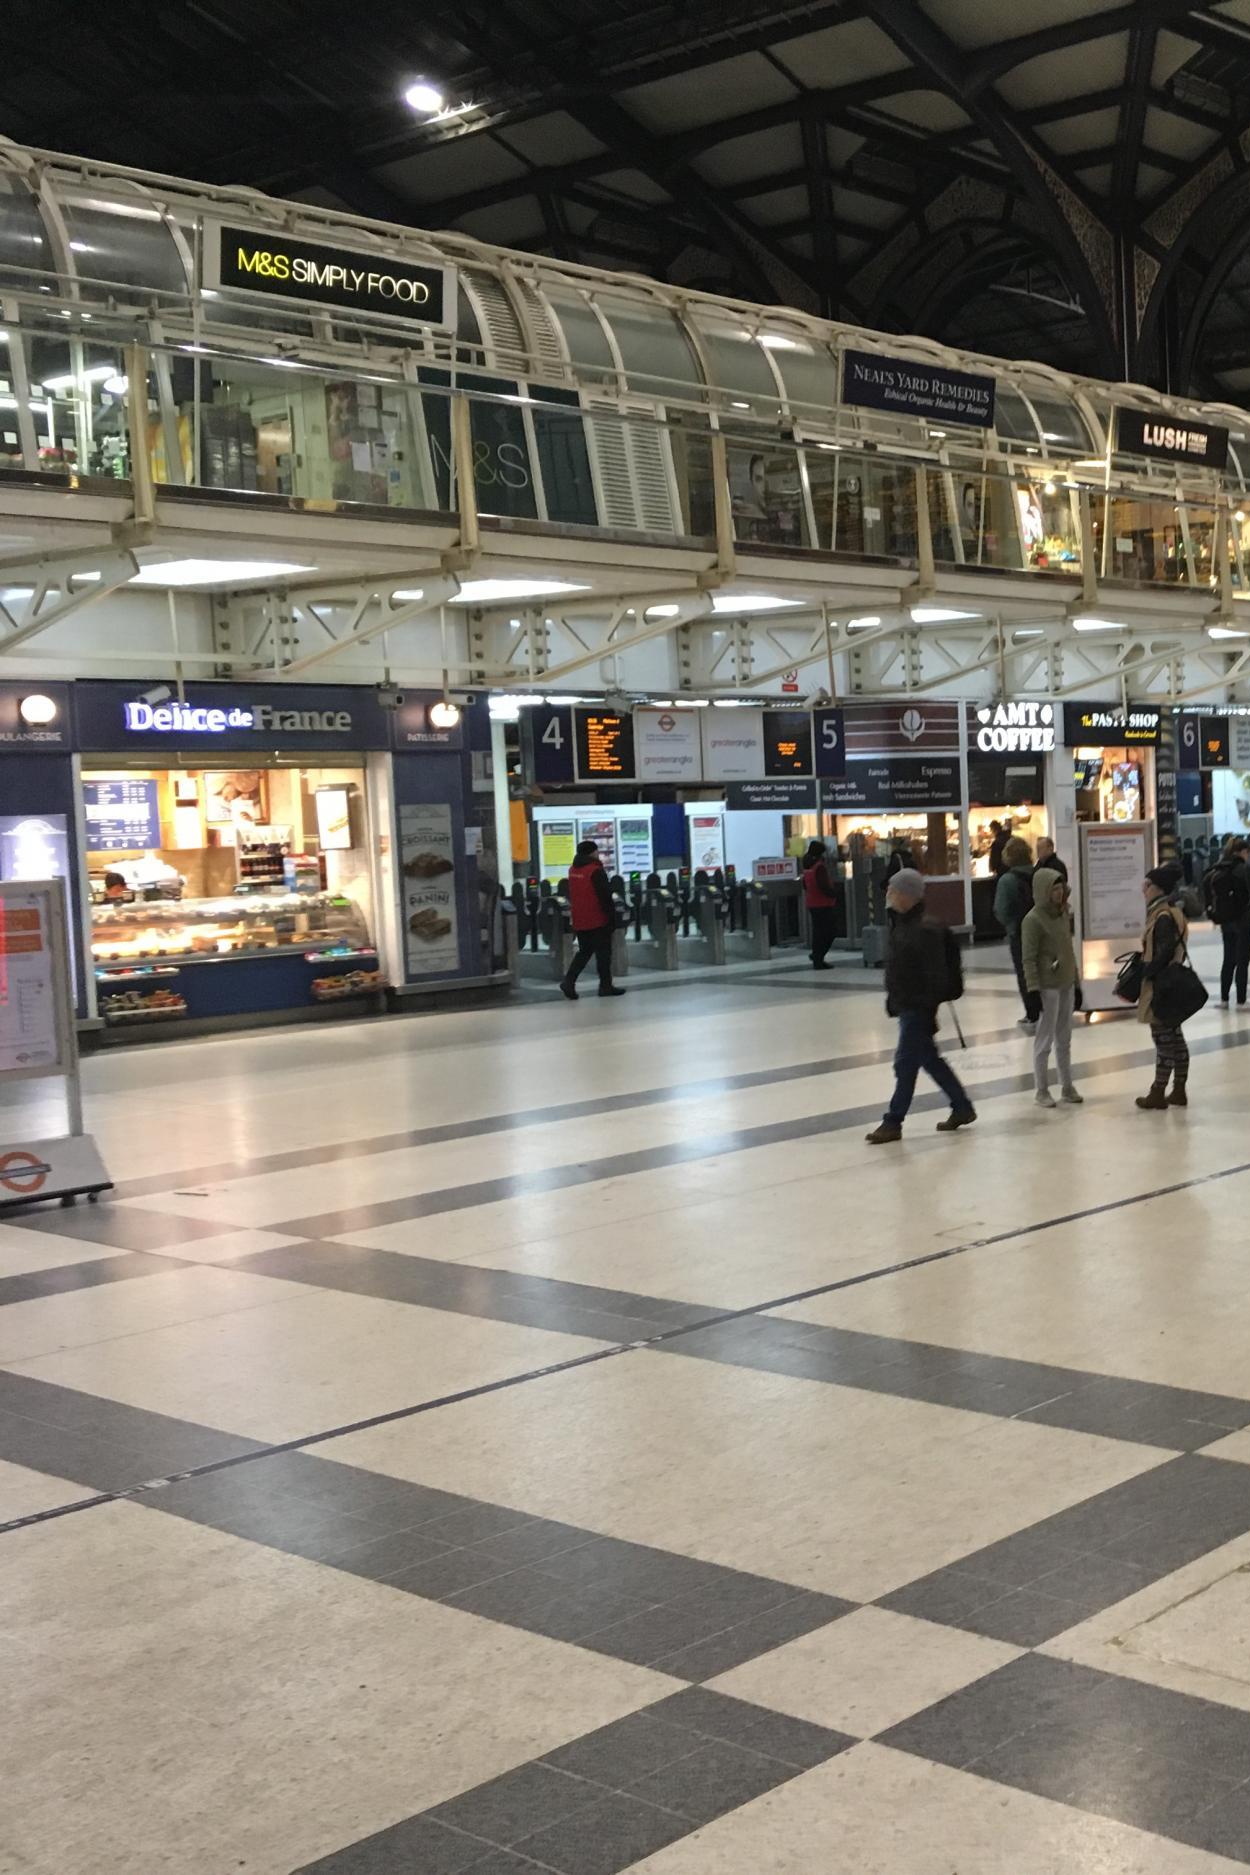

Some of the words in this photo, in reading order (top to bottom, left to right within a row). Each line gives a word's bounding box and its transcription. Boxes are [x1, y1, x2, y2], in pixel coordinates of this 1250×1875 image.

[238, 248, 289, 278] M&S
[292, 258, 364, 292] SIMPLY
[368, 272, 429, 304] FOOD
[854, 364, 895, 386] NEAL'S
[897, 372, 929, 392] YARD
[932, 379, 990, 404] REMEDIES
[1143, 423, 1188, 451] LUSH
[228, 709, 252, 727] de
[251, 705, 351, 731] France
[993, 703, 1039, 726] AMT
[1129, 713, 1159, 728] SHOP
[0, 731, 62, 741] ULANGERIE
[542, 717, 564, 750] 4
[822, 719, 837, 749] 5
[977, 728, 1056, 752] COFFEE
[1183, 721, 1195, 748] 6
[921, 766, 952, 777] Espresso
[409, 895, 450, 906] PANINI
